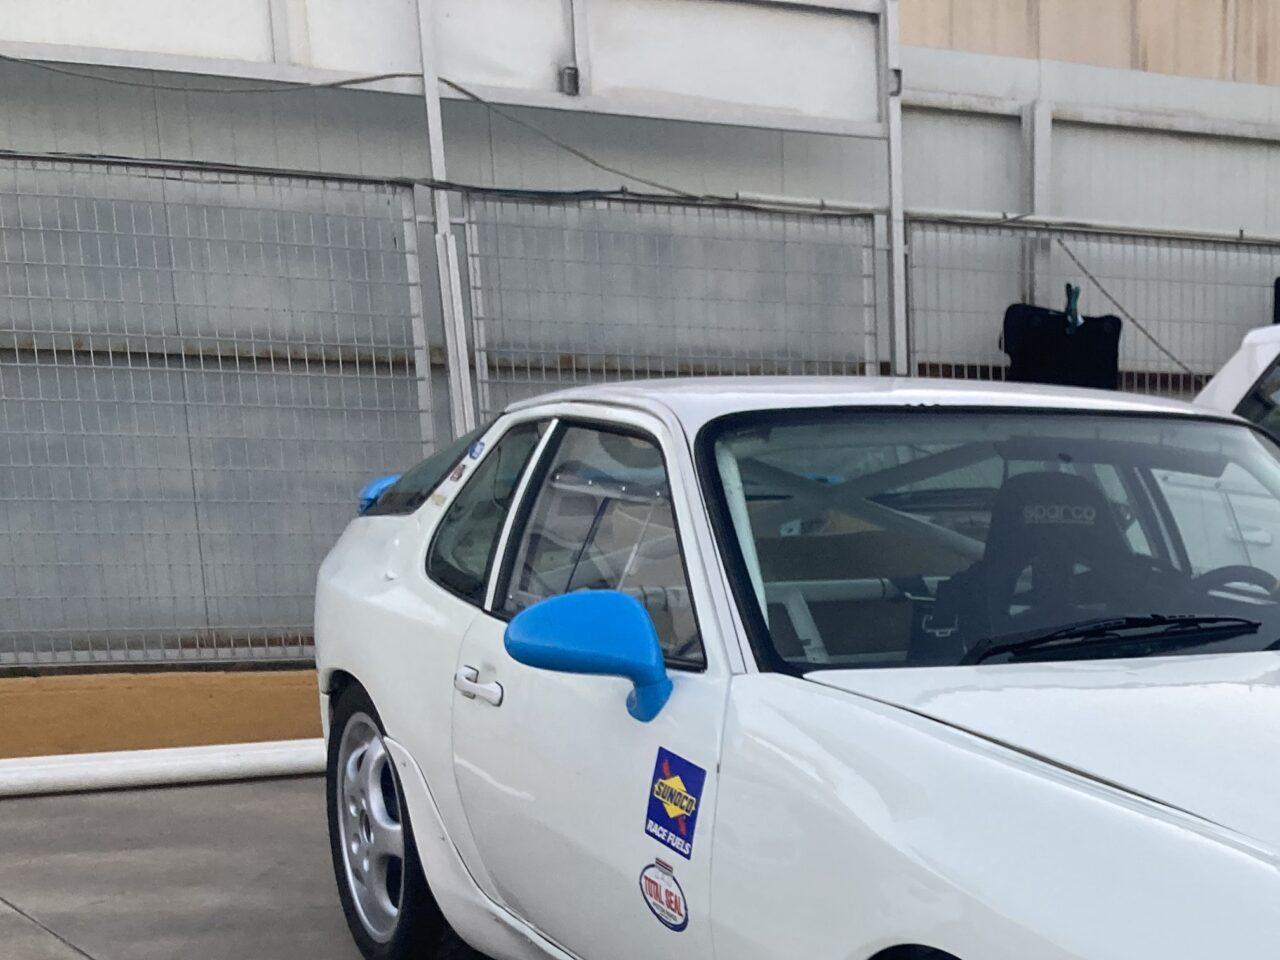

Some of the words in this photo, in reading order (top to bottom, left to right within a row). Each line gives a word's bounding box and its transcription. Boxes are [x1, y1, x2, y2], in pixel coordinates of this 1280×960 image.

[655, 780, 695, 815] SUNOCO
[646, 819, 668, 842] RACE
[667, 830, 692, 856] FUELS
[664, 888, 684, 918] SEAL
